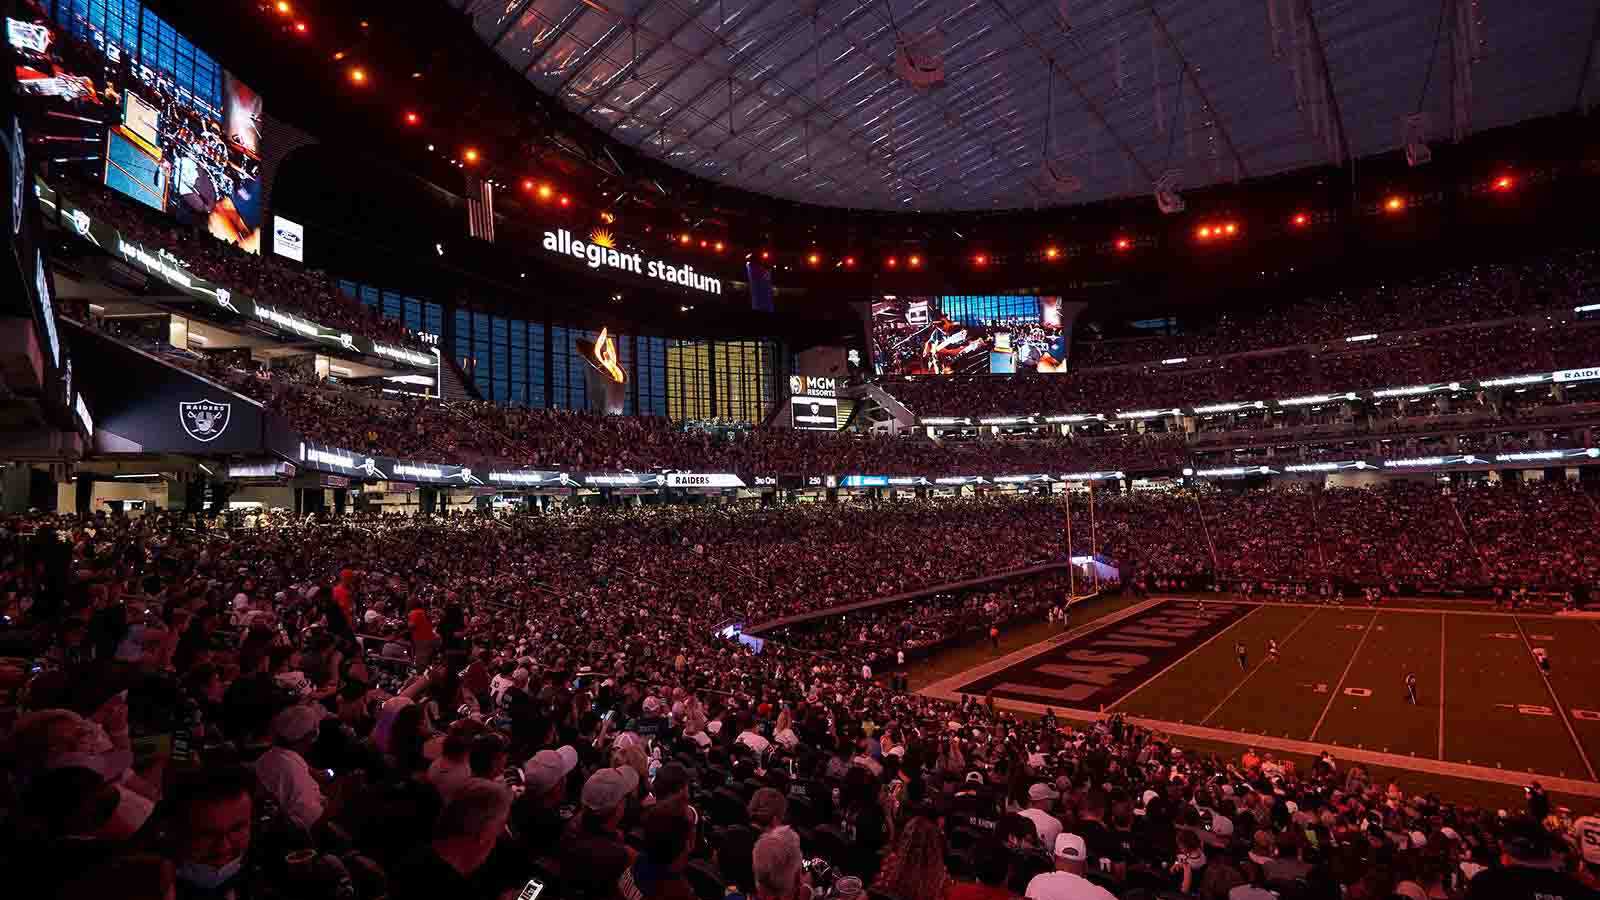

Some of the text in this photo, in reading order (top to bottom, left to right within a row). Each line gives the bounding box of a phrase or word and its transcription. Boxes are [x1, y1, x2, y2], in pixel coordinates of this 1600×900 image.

[543, 228, 721, 295] allegiant stadium
[807, 376, 836, 390] MGM
[807, 388, 836, 397] RESORTS
[675, 476, 711, 484] RAIDERS
[985, 650, 1151, 702] LAS
